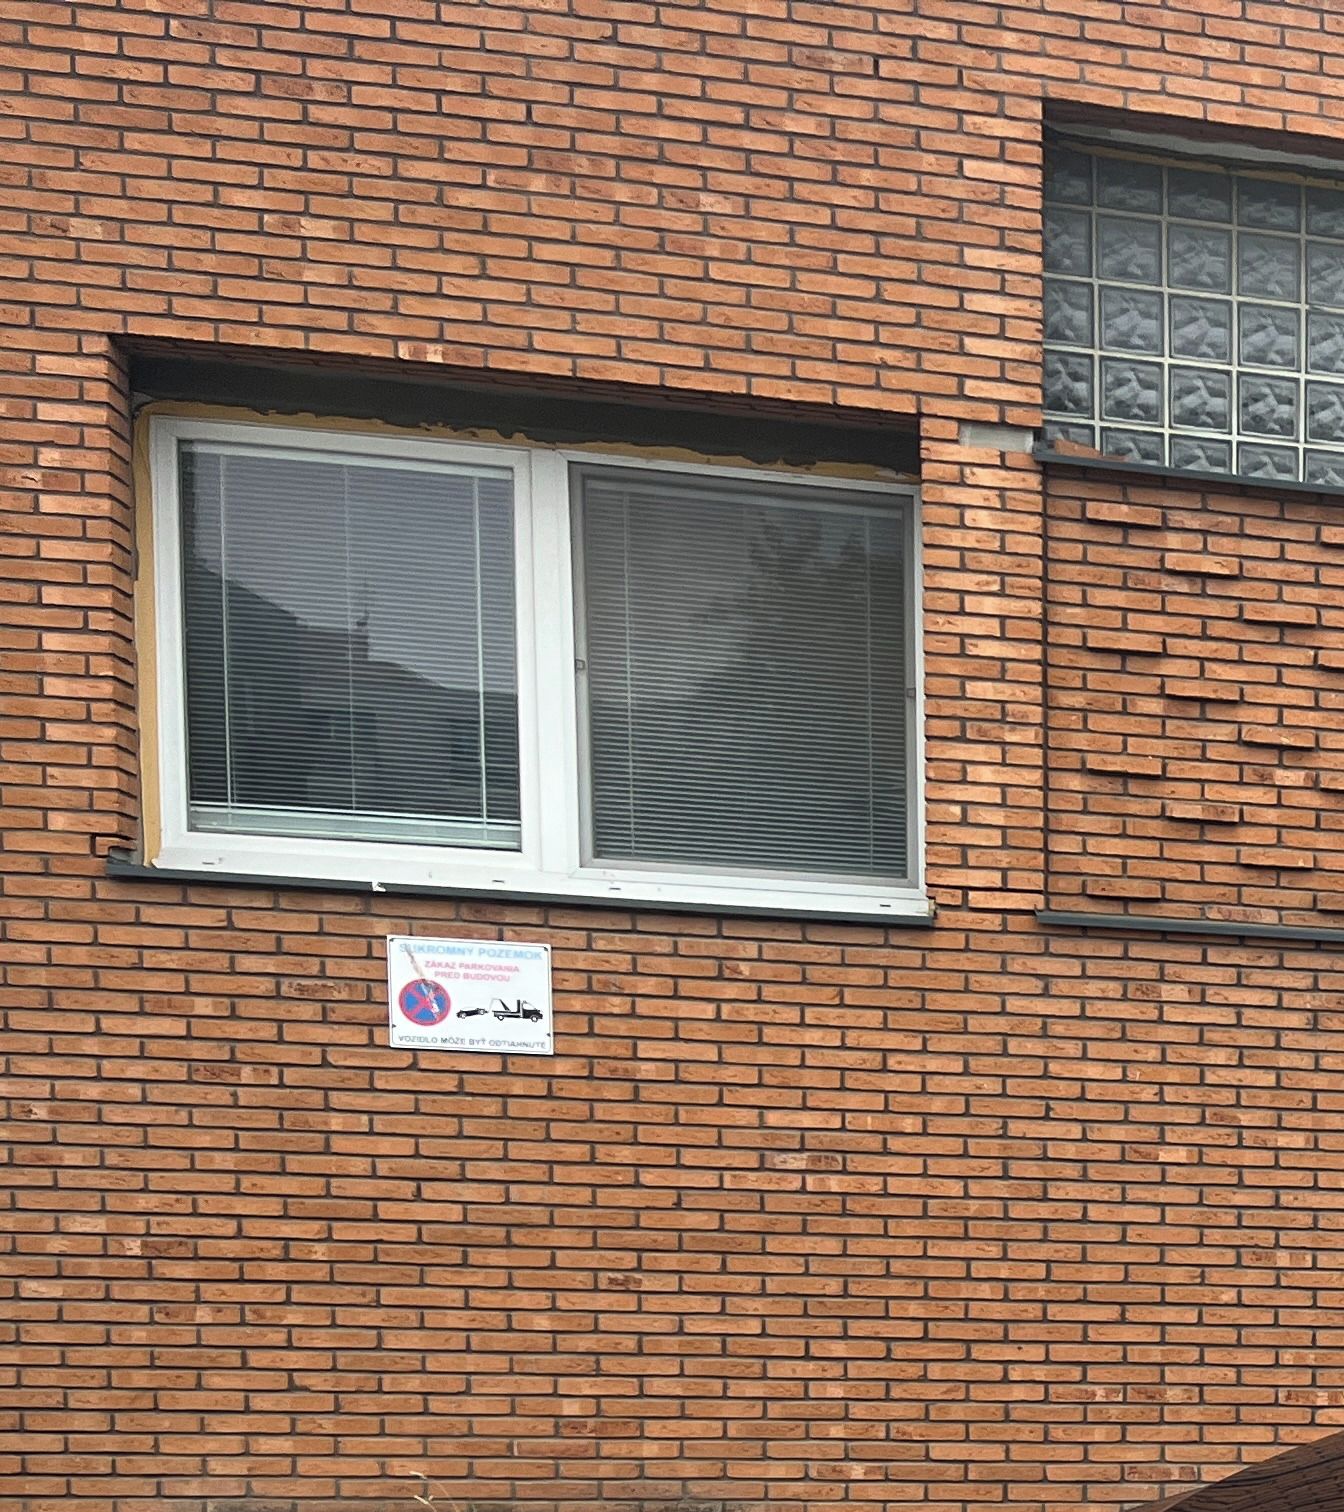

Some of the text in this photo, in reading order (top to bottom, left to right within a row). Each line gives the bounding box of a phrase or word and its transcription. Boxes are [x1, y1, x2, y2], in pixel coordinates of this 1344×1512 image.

[478, 947, 543, 960] POZEMOK
[463, 972, 511, 982] BUDOVOU
[398, 1035, 438, 1044] VOZIDLO
